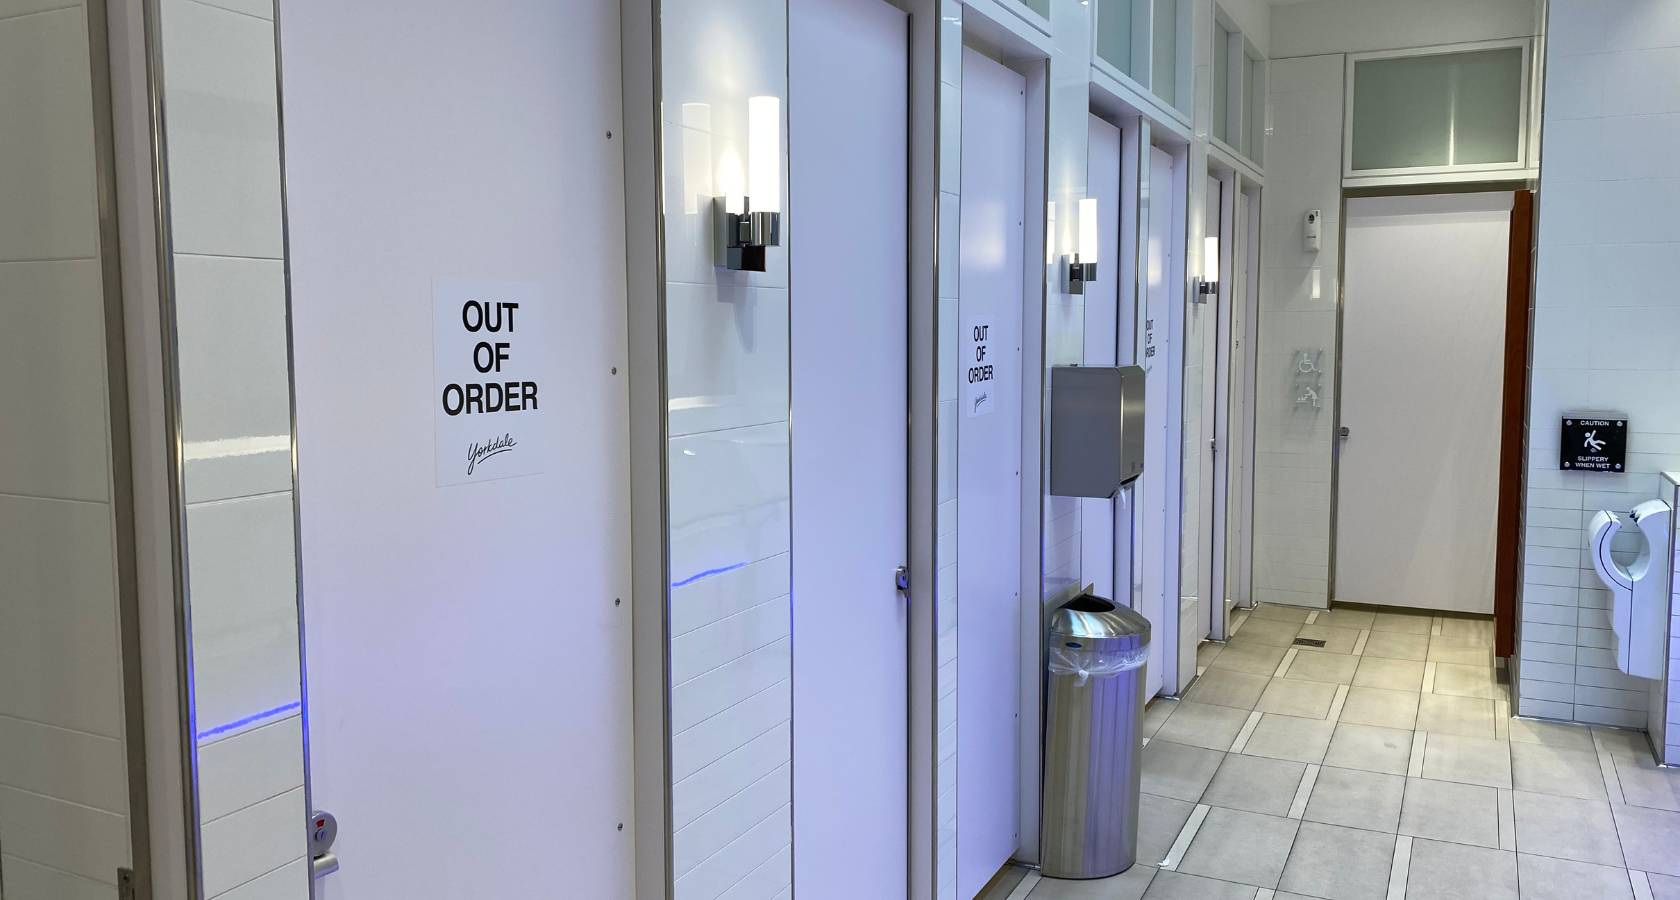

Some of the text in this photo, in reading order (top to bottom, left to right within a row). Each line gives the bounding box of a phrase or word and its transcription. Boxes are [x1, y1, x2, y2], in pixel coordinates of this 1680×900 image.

[462, 300, 519, 333] OUT
[974, 325, 989, 342] OUT
[473, 341, 511, 373] OF
[976, 346, 986, 362] OF
[968, 365, 994, 383] ORDER
[442, 381, 538, 416] ORDER
[467, 433, 518, 475] Yorkdale
